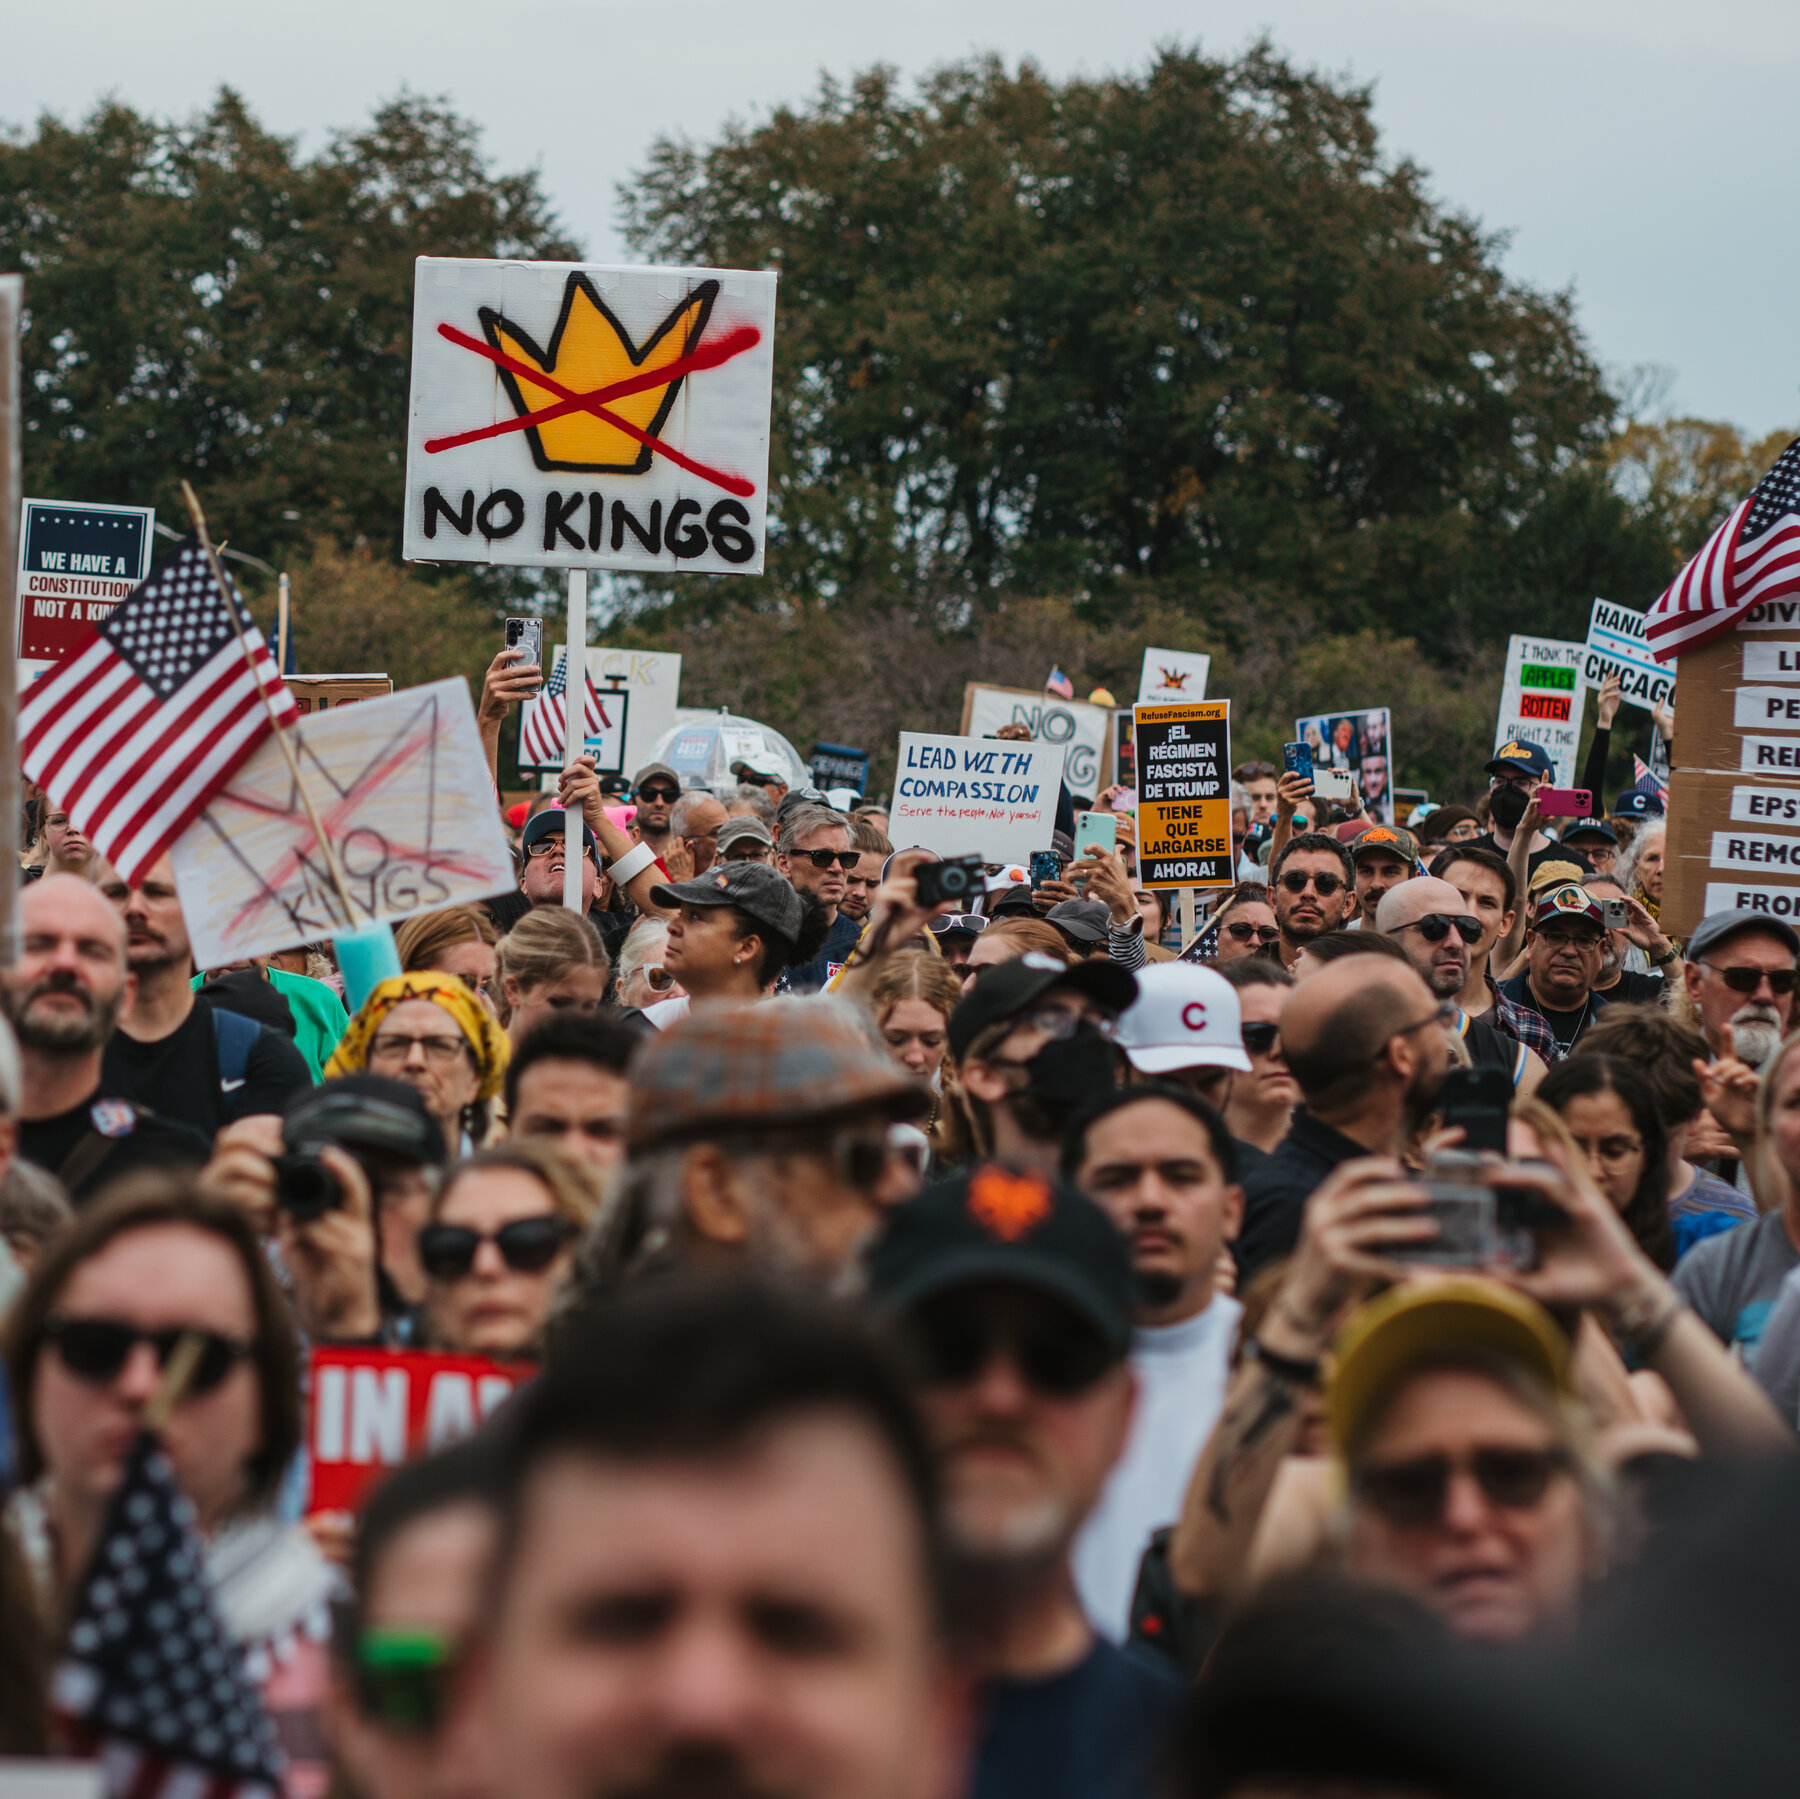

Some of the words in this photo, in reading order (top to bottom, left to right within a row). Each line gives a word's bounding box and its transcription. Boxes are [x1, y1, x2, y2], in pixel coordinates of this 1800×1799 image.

[423, 486, 524, 540] NO
[543, 490, 756, 564] KINGS
[41, 551, 66, 570] WE
[70, 553, 111, 574] HAVE
[114, 557, 126, 575] A
[29, 576, 134, 597] CONSTITUTION
[33, 599, 66, 618] NOT
[70, 601, 82, 620] A
[1746, 602, 1800, 622] DIV
[1520, 643, 1529, 659] I
[1141, 709, 1221, 720] RefuseFascism.org
[1521, 695, 1571, 721] ROTTEN
[1011, 704, 1076, 744] NO
[1168, 725, 1191, 743] ¡EL
[1507, 723, 1542, 740] RIGHT
[1556, 730, 1575, 745] THE
[907, 746, 957, 770] LEAD
[964, 750, 1033, 775] WITH
[1149, 741, 1217, 760] RÉGIMEN
[1146, 762, 1218, 779] FASCISTA
[899, 777, 1040, 803] COMPASSION
[1145, 783, 1163, 799] DE
[1165, 781, 1220, 798] TRUMP
[898, 804, 933, 817] Serve
[937, 805, 956, 817] the
[1157, 805, 1203, 820] TIENE
[1749, 795, 1800, 818] EPS
[1165, 822, 1199, 839] QUE
[1144, 838, 1226, 855] LARGARSE
[1153, 861, 1216, 878] AHORA!
[1182, 1002, 1207, 1031] C
[317, 1364, 411, 1466] IN
